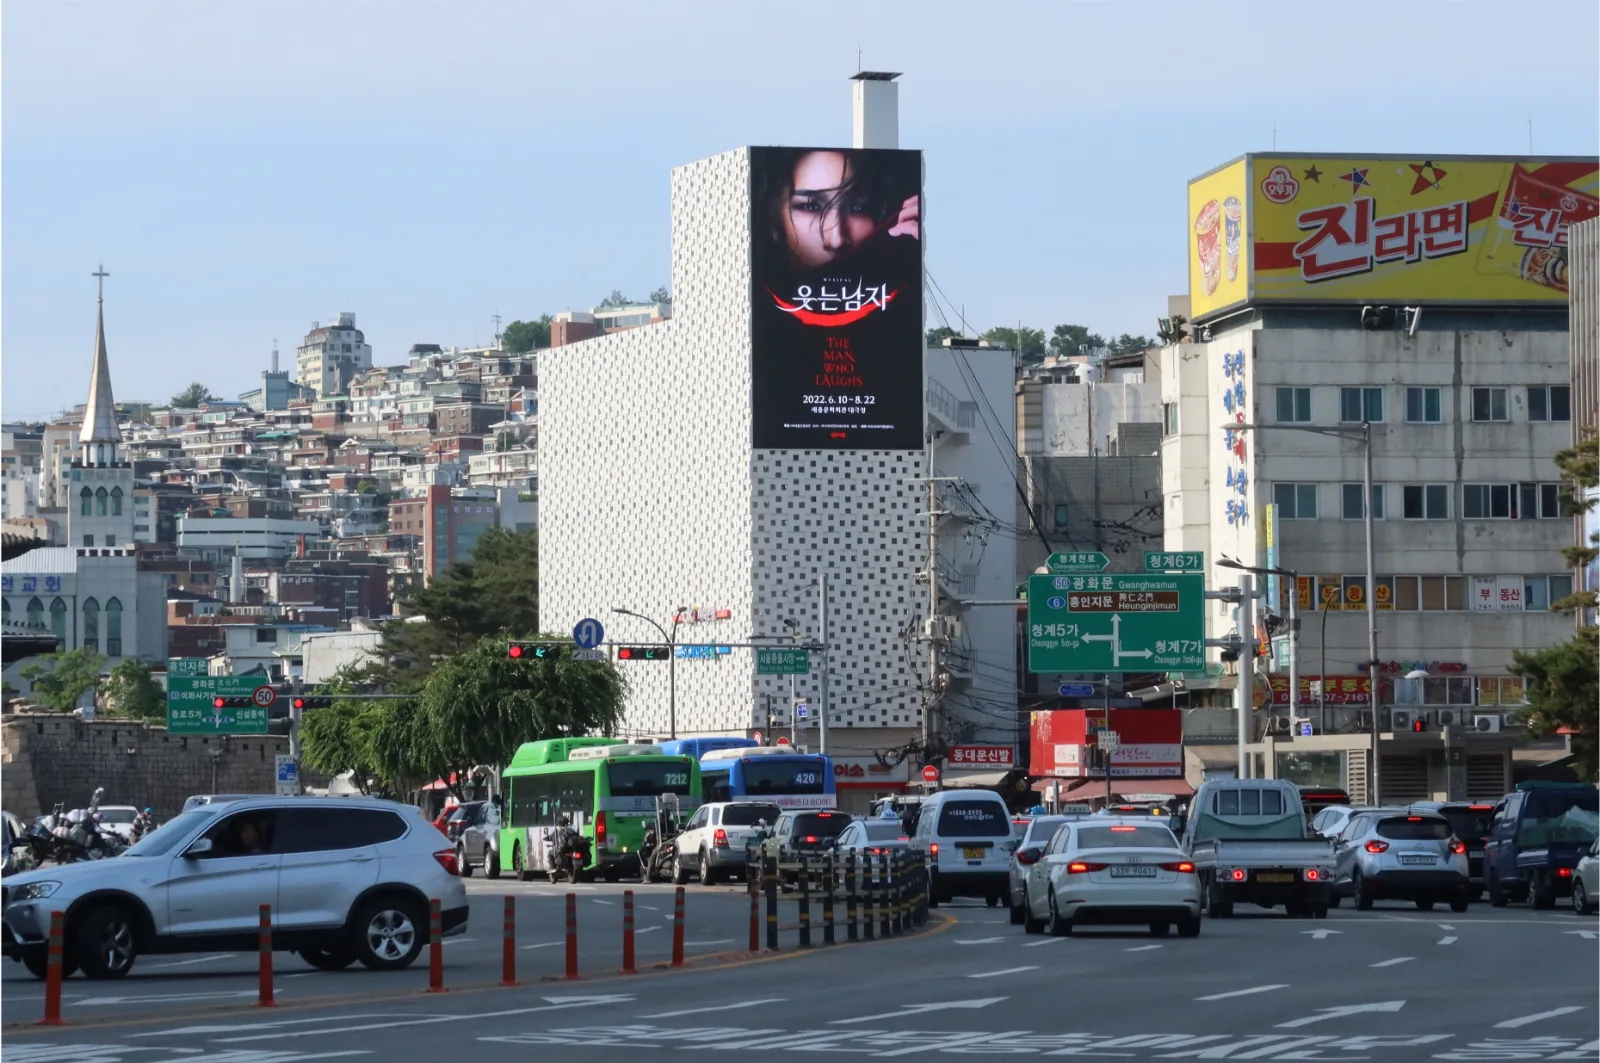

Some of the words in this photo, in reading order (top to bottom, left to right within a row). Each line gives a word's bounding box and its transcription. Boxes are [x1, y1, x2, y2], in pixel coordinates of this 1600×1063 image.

[1267, 182, 1293, 197] 오뚜기
[1296, 198, 1467, 282] 진라면
[775, 276, 892, 312] 웃는남자
[826, 337, 850, 349] THE
[824, 351, 856, 363] MAN
[823, 363, 854, 374] WHO
[815, 374, 863, 387] LAUGHS
[1059, 554, 1095, 564] 청계천로
[1150, 554, 1198, 568] 청계6가
[1073, 577, 1113, 590] 광화문
[1119, 580, 1177, 590] Gwanghwamun
[1053, 598, 1060, 607] 6
[1069, 596, 1113, 608] 흥인지문
[1119, 592, 1154, 602] 興仁之門
[1119, 601, 1176, 611] Heunginjimun
[1032, 623, 1079, 637] 청계5가
[1155, 640, 1202, 654] 청계7가
[169, 660, 207, 671] 흥인지문
[192, 681, 215, 689] 광화문
[257, 691, 271, 702] 50
[171, 710, 202, 719] 종로5가
[236, 710, 265, 719] 신설동역
[953, 749, 1010, 762] 동대문신발
[665, 773, 687, 785] 7212
[795, 773, 815, 784] 420
[1133, 867, 1151, 875] 9041
